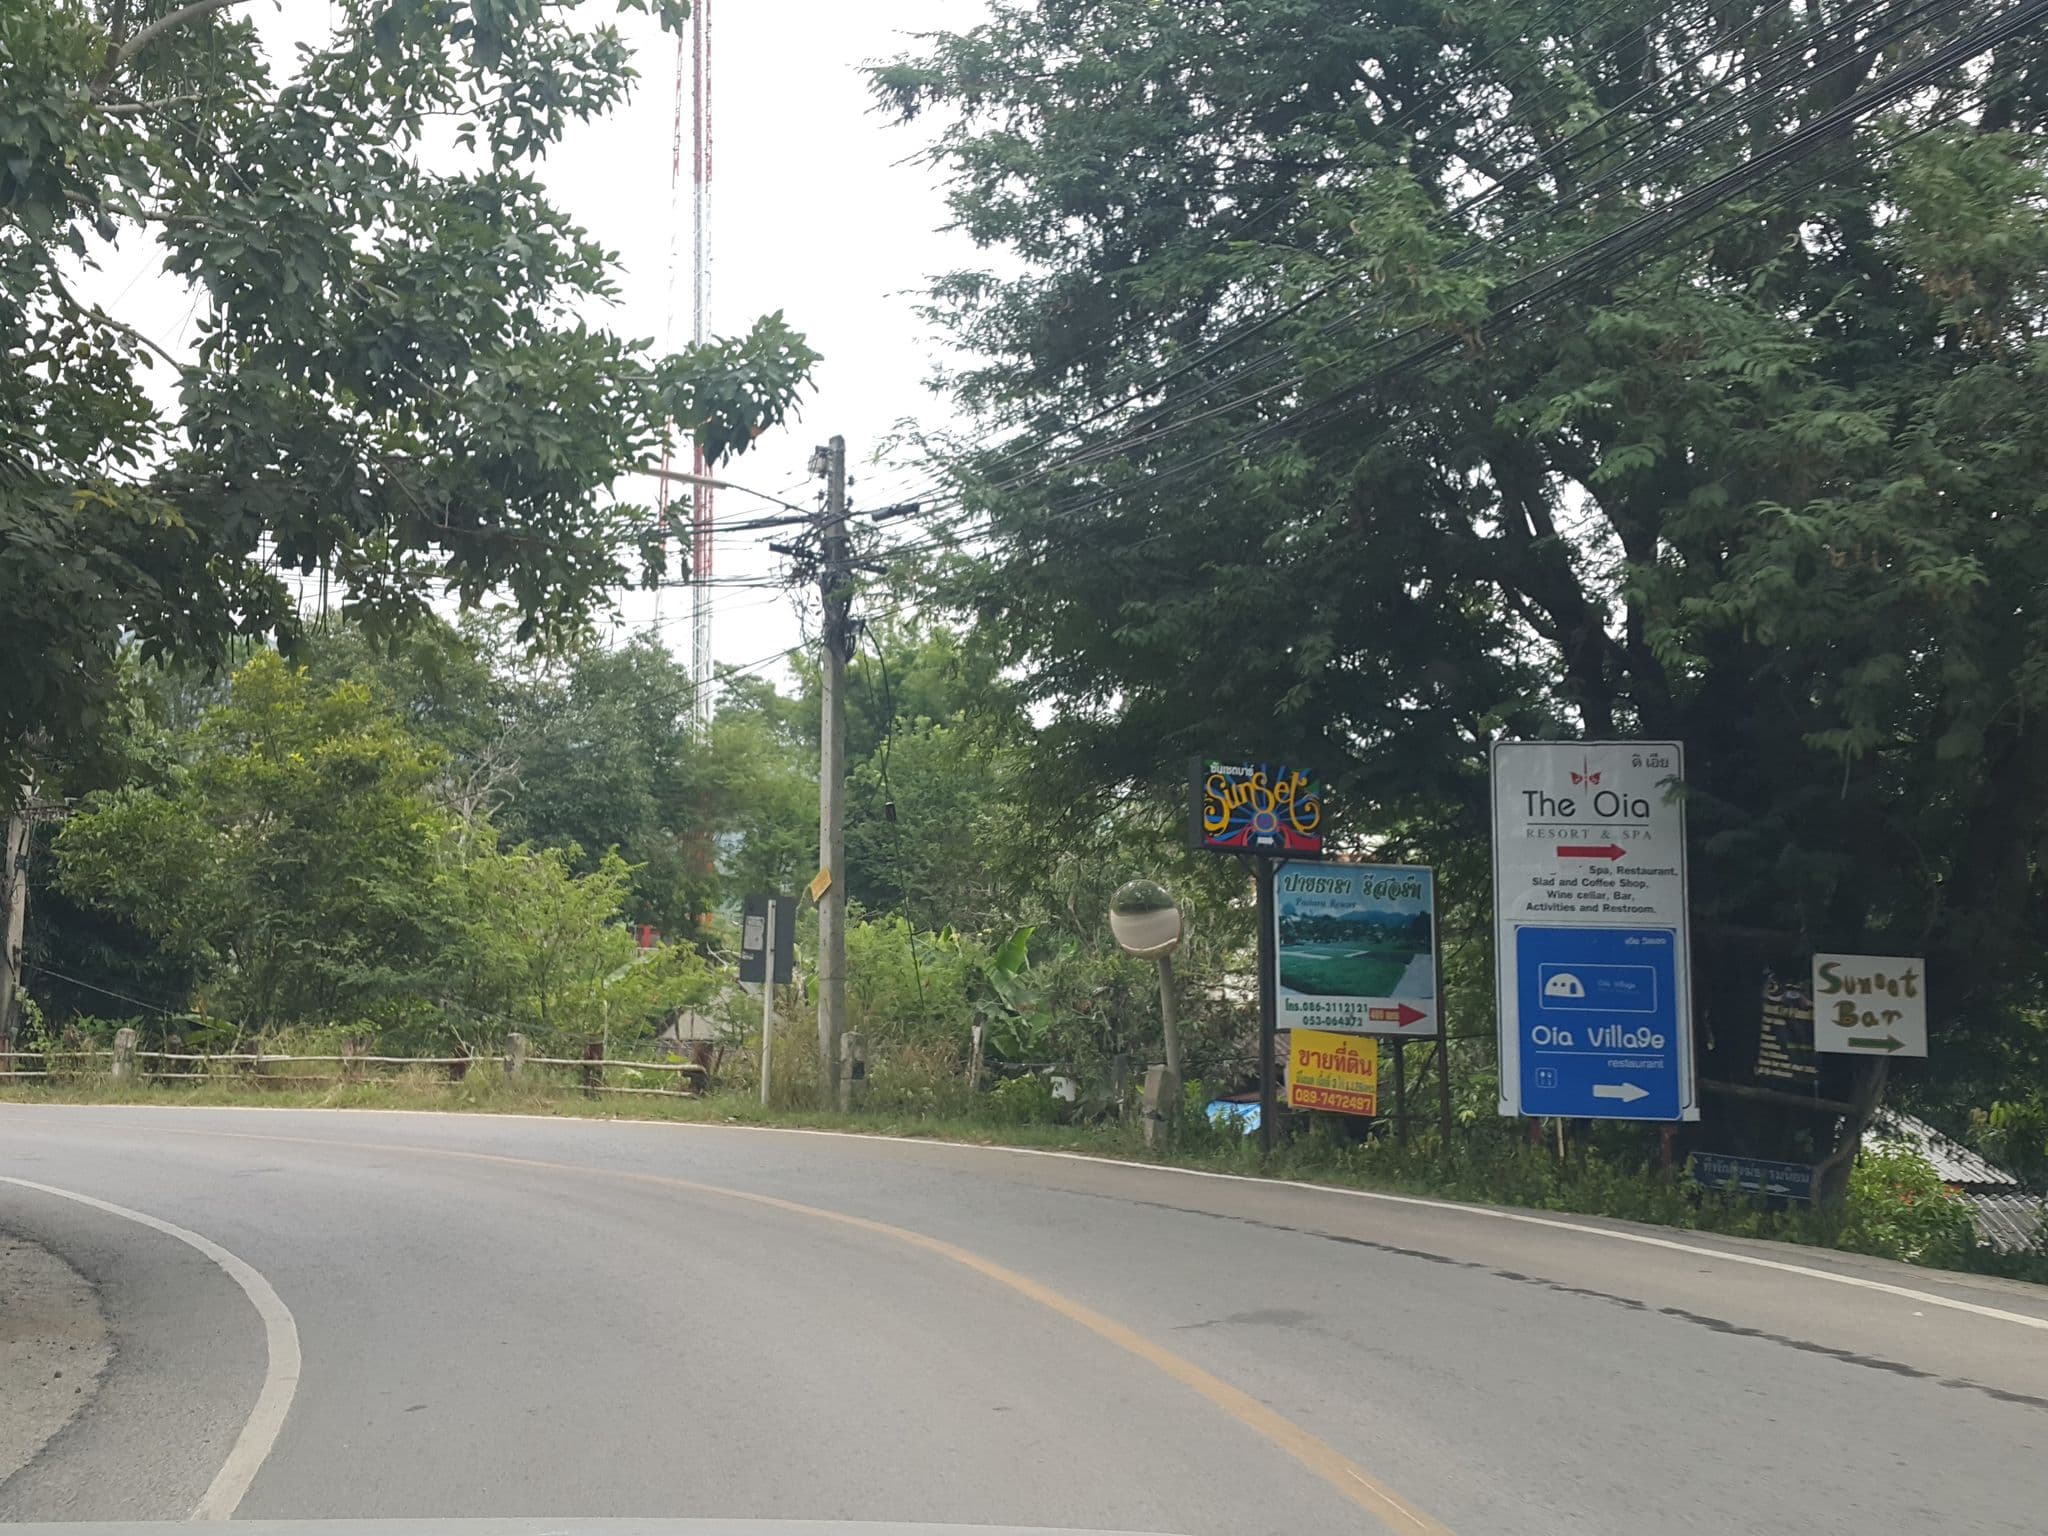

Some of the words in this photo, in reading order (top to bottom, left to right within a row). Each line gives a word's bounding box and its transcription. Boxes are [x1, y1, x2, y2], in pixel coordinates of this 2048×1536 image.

[1203, 772, 1321, 835] Sunset
[1522, 790, 1576, 817] The
[1594, 790, 1651, 818] Oia
[1526, 828, 1590, 839] RESORT
[1600, 830, 1611, 840] &
[1623, 830, 1653, 840] SPA
[1589, 865, 1613, 876] Spa,
[1558, 878, 1579, 887] and
[1582, 878, 1615, 888] Coffee
[1546, 890, 1574, 899] Wine
[1526, 902, 1575, 912] Activities
[1579, 903, 1600, 913] and
[1602, 903, 1657, 914] Restroom.
[1831, 1000, 1904, 1028] Bar
[1530, 1025, 1574, 1046] Oia
[1298, 1041, 1373, 1076] ขายที่ดิน
[1607, 1058, 1664, 1069] restaurant
